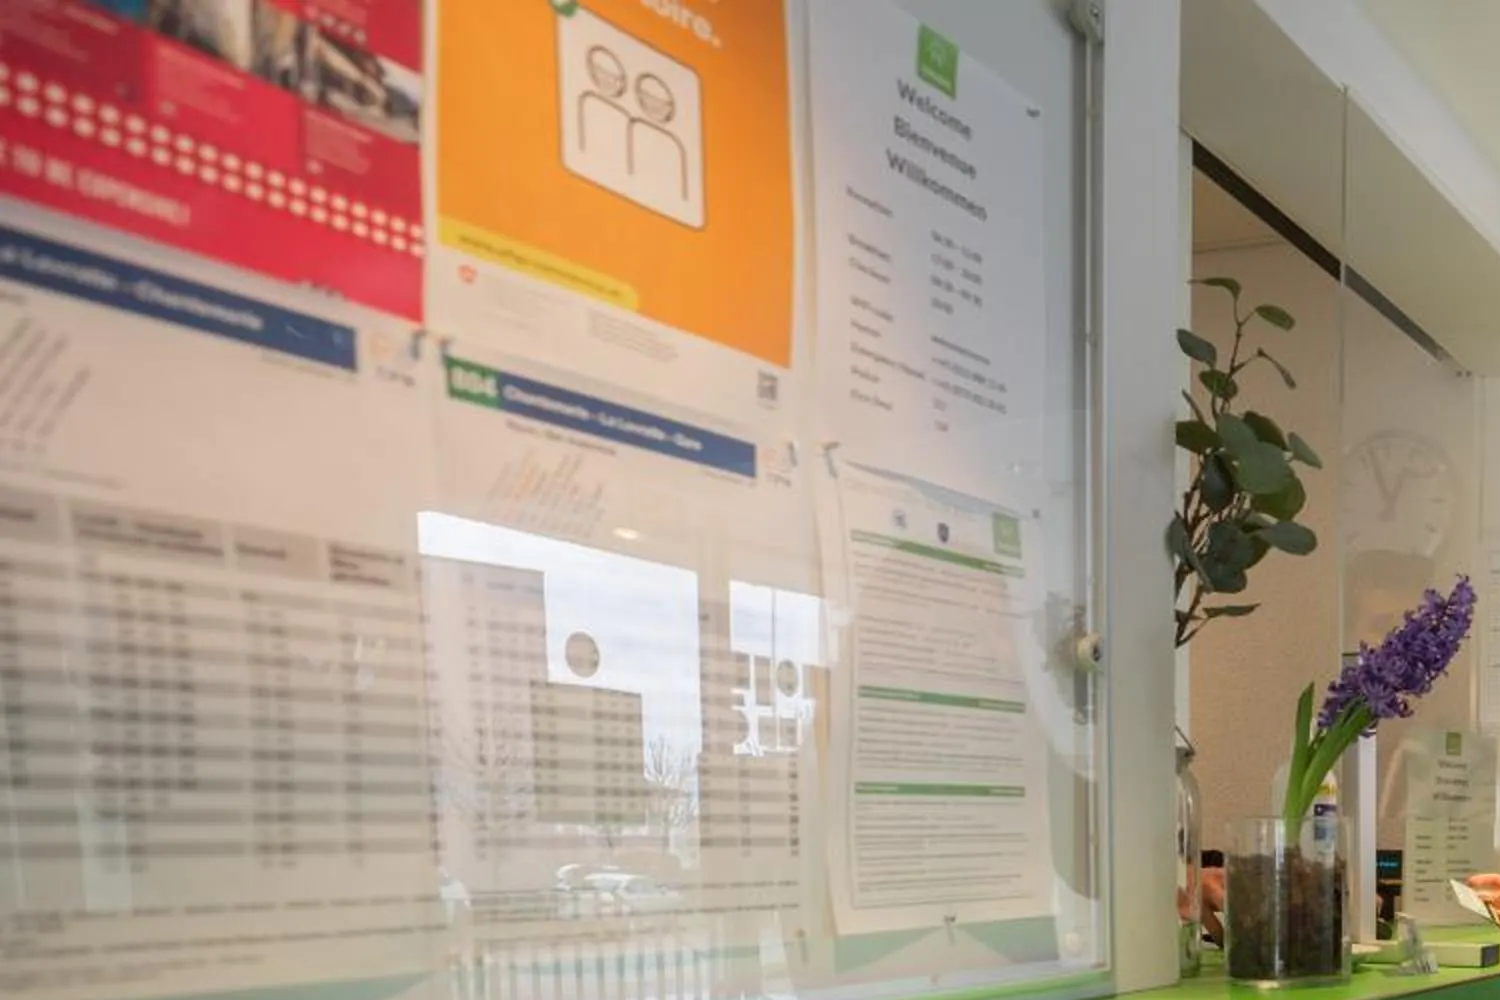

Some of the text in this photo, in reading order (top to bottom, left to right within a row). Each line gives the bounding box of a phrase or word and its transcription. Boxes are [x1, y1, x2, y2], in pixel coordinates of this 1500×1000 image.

[896, 77, 972, 141] Welcome
[893, 114, 977, 181] Bienvenue
[885, 147, 988, 223] Willkommen
